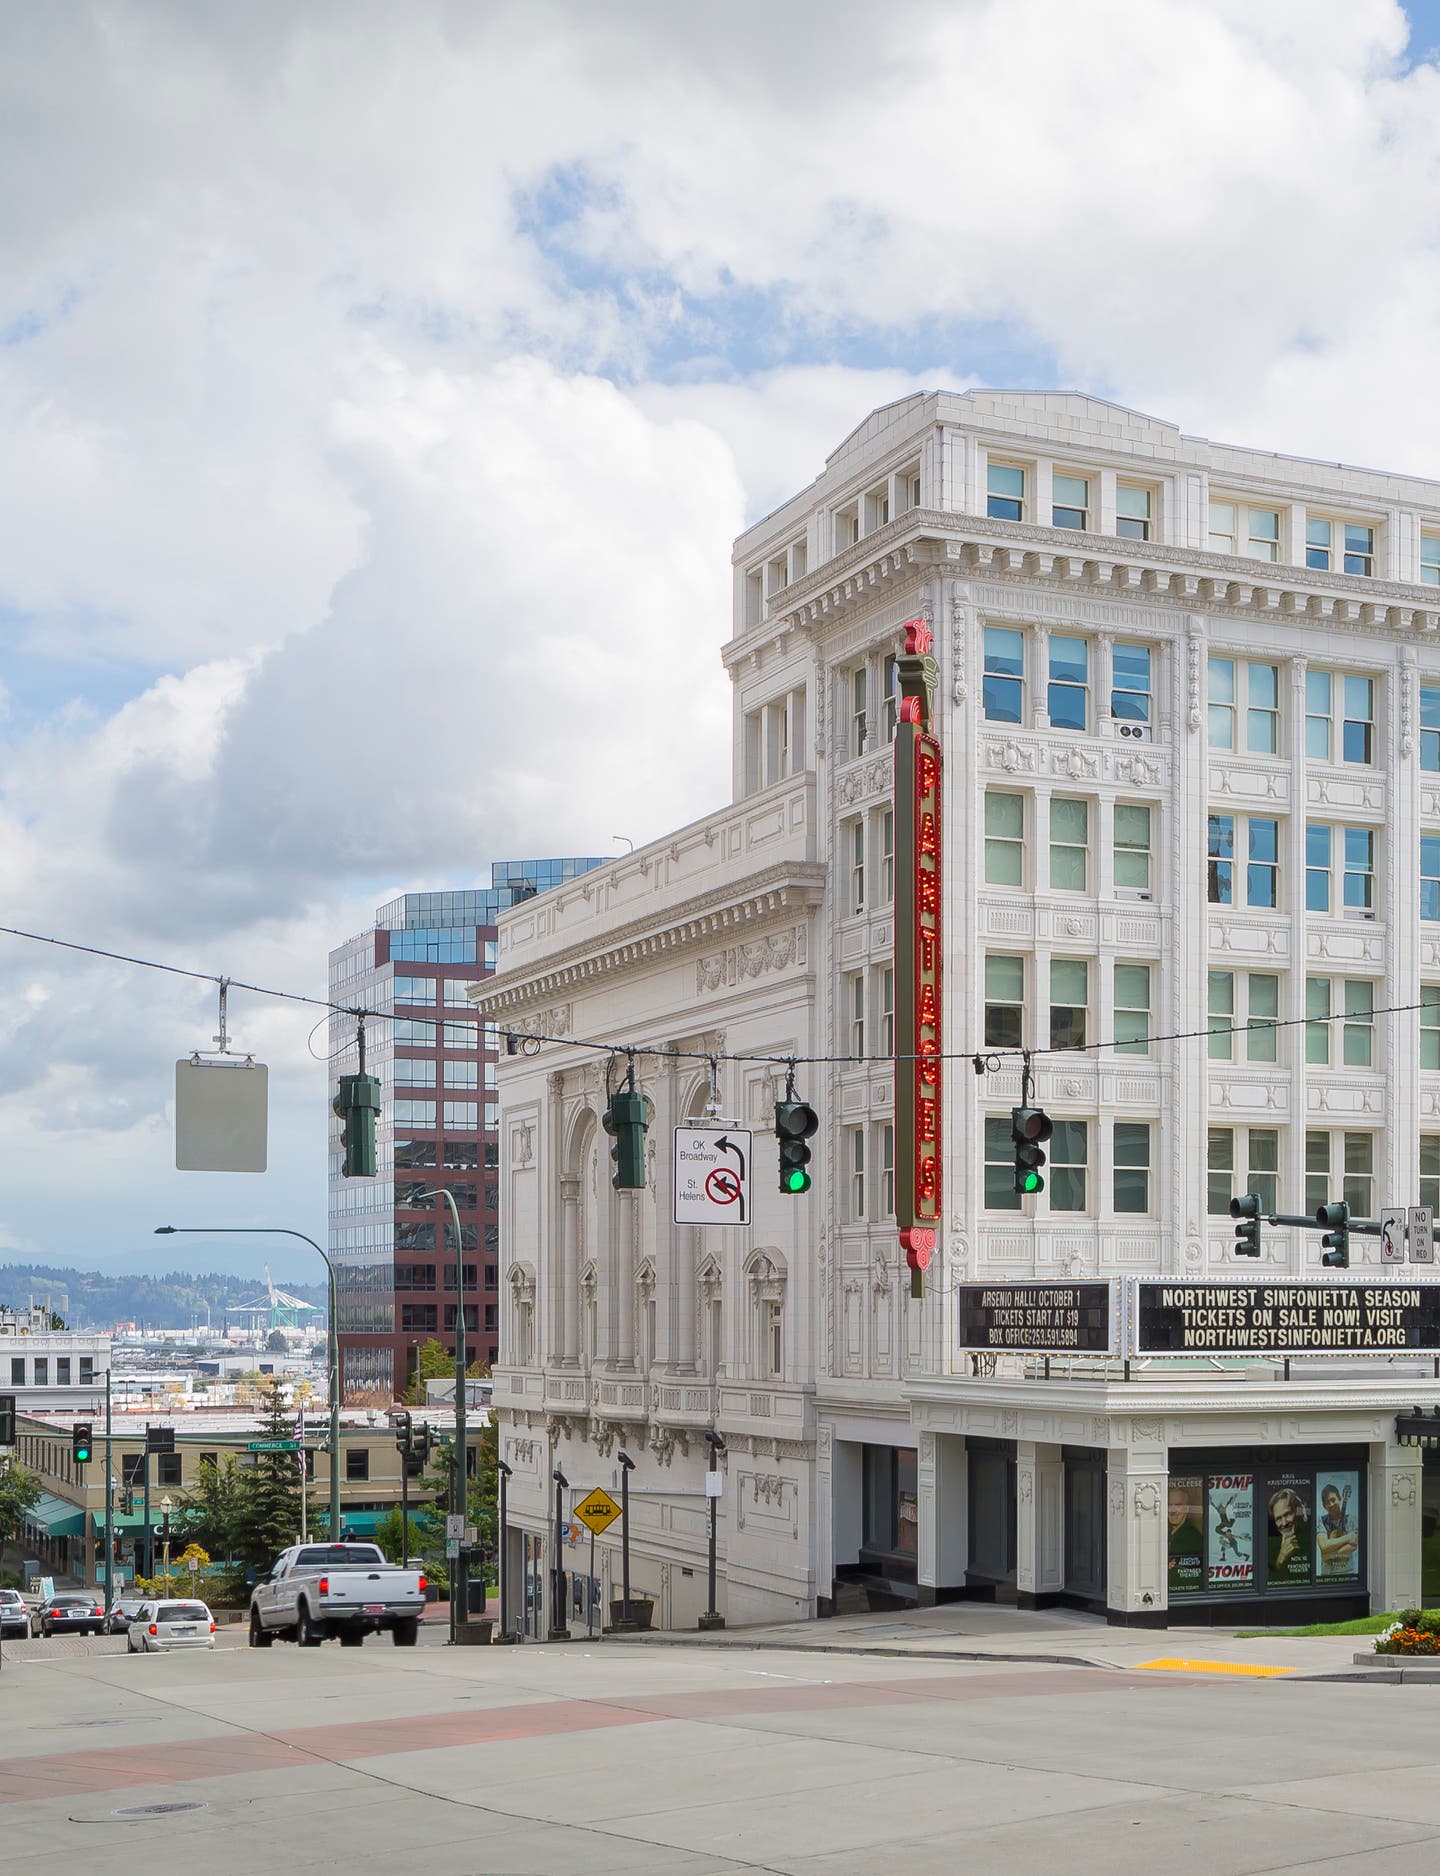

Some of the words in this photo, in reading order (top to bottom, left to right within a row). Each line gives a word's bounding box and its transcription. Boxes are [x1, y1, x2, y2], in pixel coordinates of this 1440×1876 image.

[919, 752, 937, 1199] PANTAGES
[692, 1140, 705, 1150] OK
[680, 1151, 717, 1163] Broadway
[687, 1179, 698, 1189] St.
[680, 1191, 705, 1201] Helens
[1415, 1211, 1426, 1222] NO
[1413, 1225, 1428, 1234] TURN
[1416, 1238, 1425, 1247] ON
[1416, 1249, 1427, 1259] RED
[982, 1291, 1012, 1307] ARSENIO
[1014, 1291, 1036, 1307] HALL!
[1038, 1290, 1073, 1307] OCTOBER
[1076, 1290, 1080, 1306] 1
[1162, 1289, 1257, 1307] NORTHWEST
[1263, 1290, 1359, 1307] SINFONIETTA
[1365, 1290, 1420, 1307] SEASON
[993, 1310, 1024, 1326] TICKETS
[1026, 1310, 1052, 1326] START
[1054, 1310, 1064, 1326] AT
[1066, 1310, 1079, 1326] $19
[1182, 1309, 1246, 1327] TICKETS
[1252, 1309, 1272, 1327] ON
[1279, 1309, 1317, 1326] SALE
[1323, 1309, 1360, 1326] NOW!
[1366, 1309, 1403, 1326] VISIT
[989, 1328, 1003, 1344] BOX
[1184, 1328, 1406, 1346] NORTHWESTSINFONIETTA.ORG
[1177, 1480, 1203, 1488] CLEESE
[1208, 1476, 1254, 1489] STOMP
[1208, 1565, 1254, 1579] STOMP
